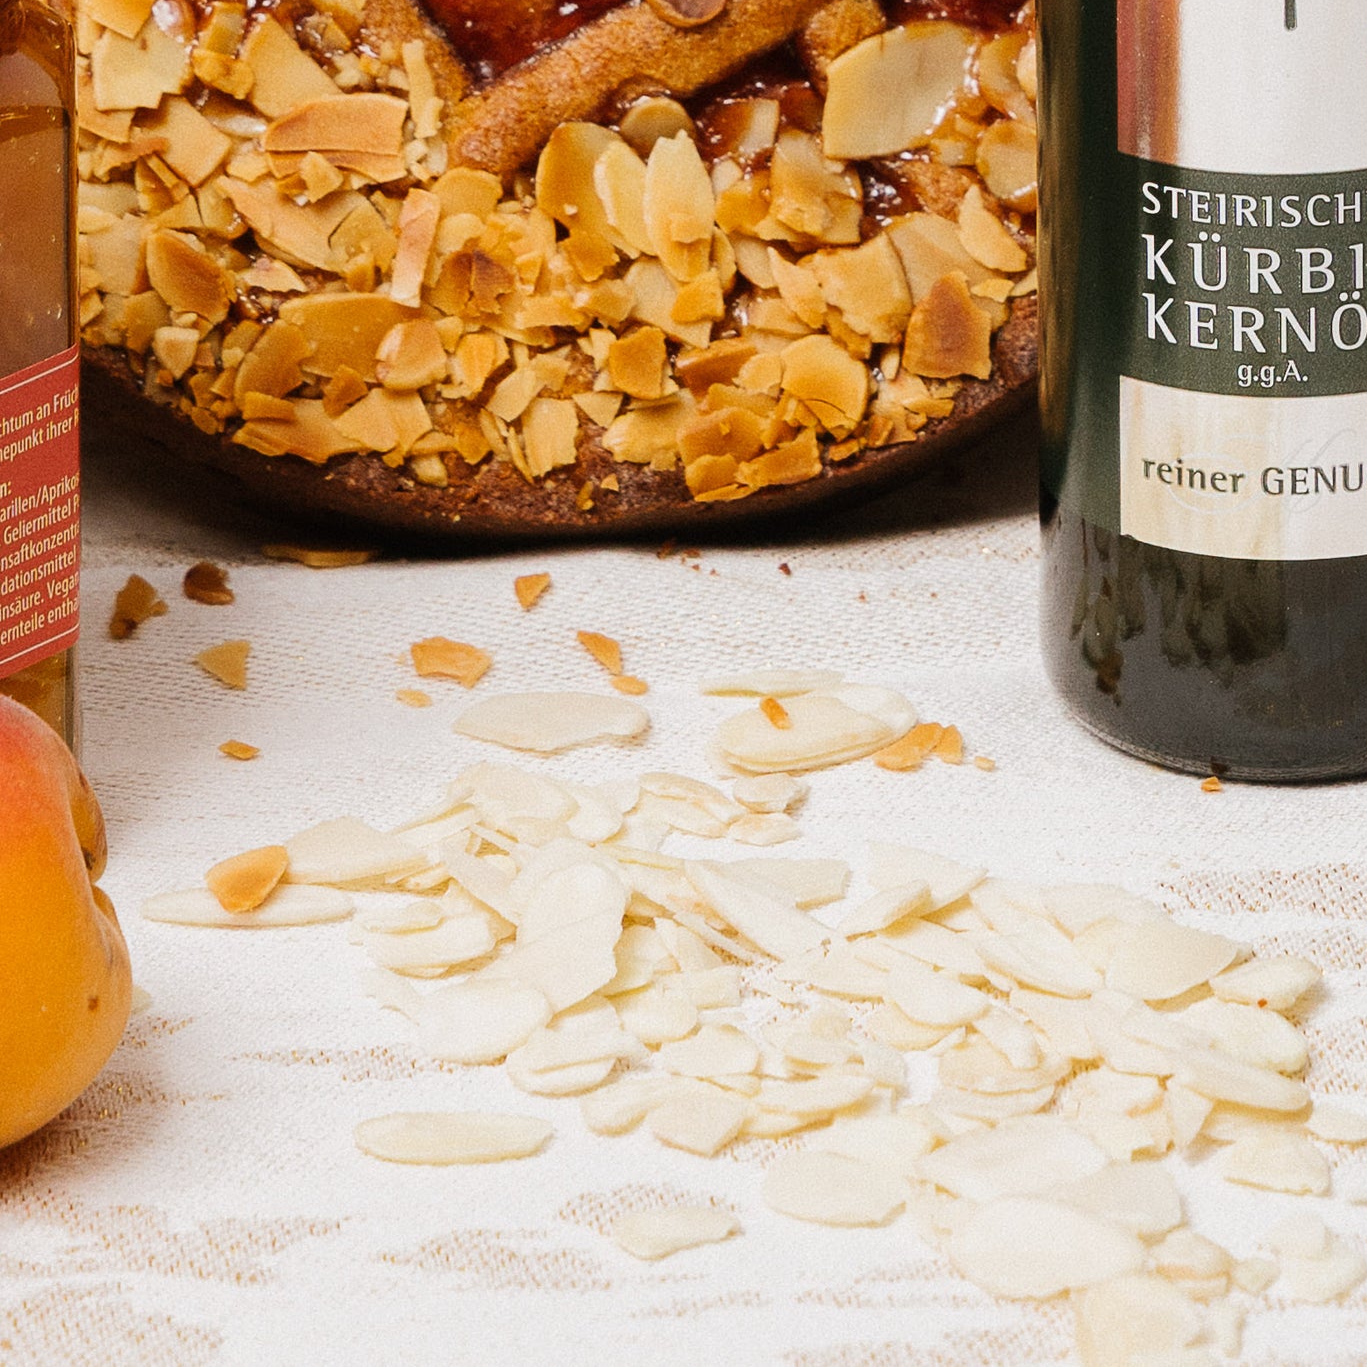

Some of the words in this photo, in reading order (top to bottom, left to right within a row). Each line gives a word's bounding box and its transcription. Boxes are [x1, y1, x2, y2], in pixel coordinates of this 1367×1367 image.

[1237, 360, 1309, 388] g.g.A.
[36, 402, 51, 421] an
[46, 416, 73, 441] ihrer
[1141, 458, 1246, 495] reiner
[3, 498, 71, 545] Geliermittel
